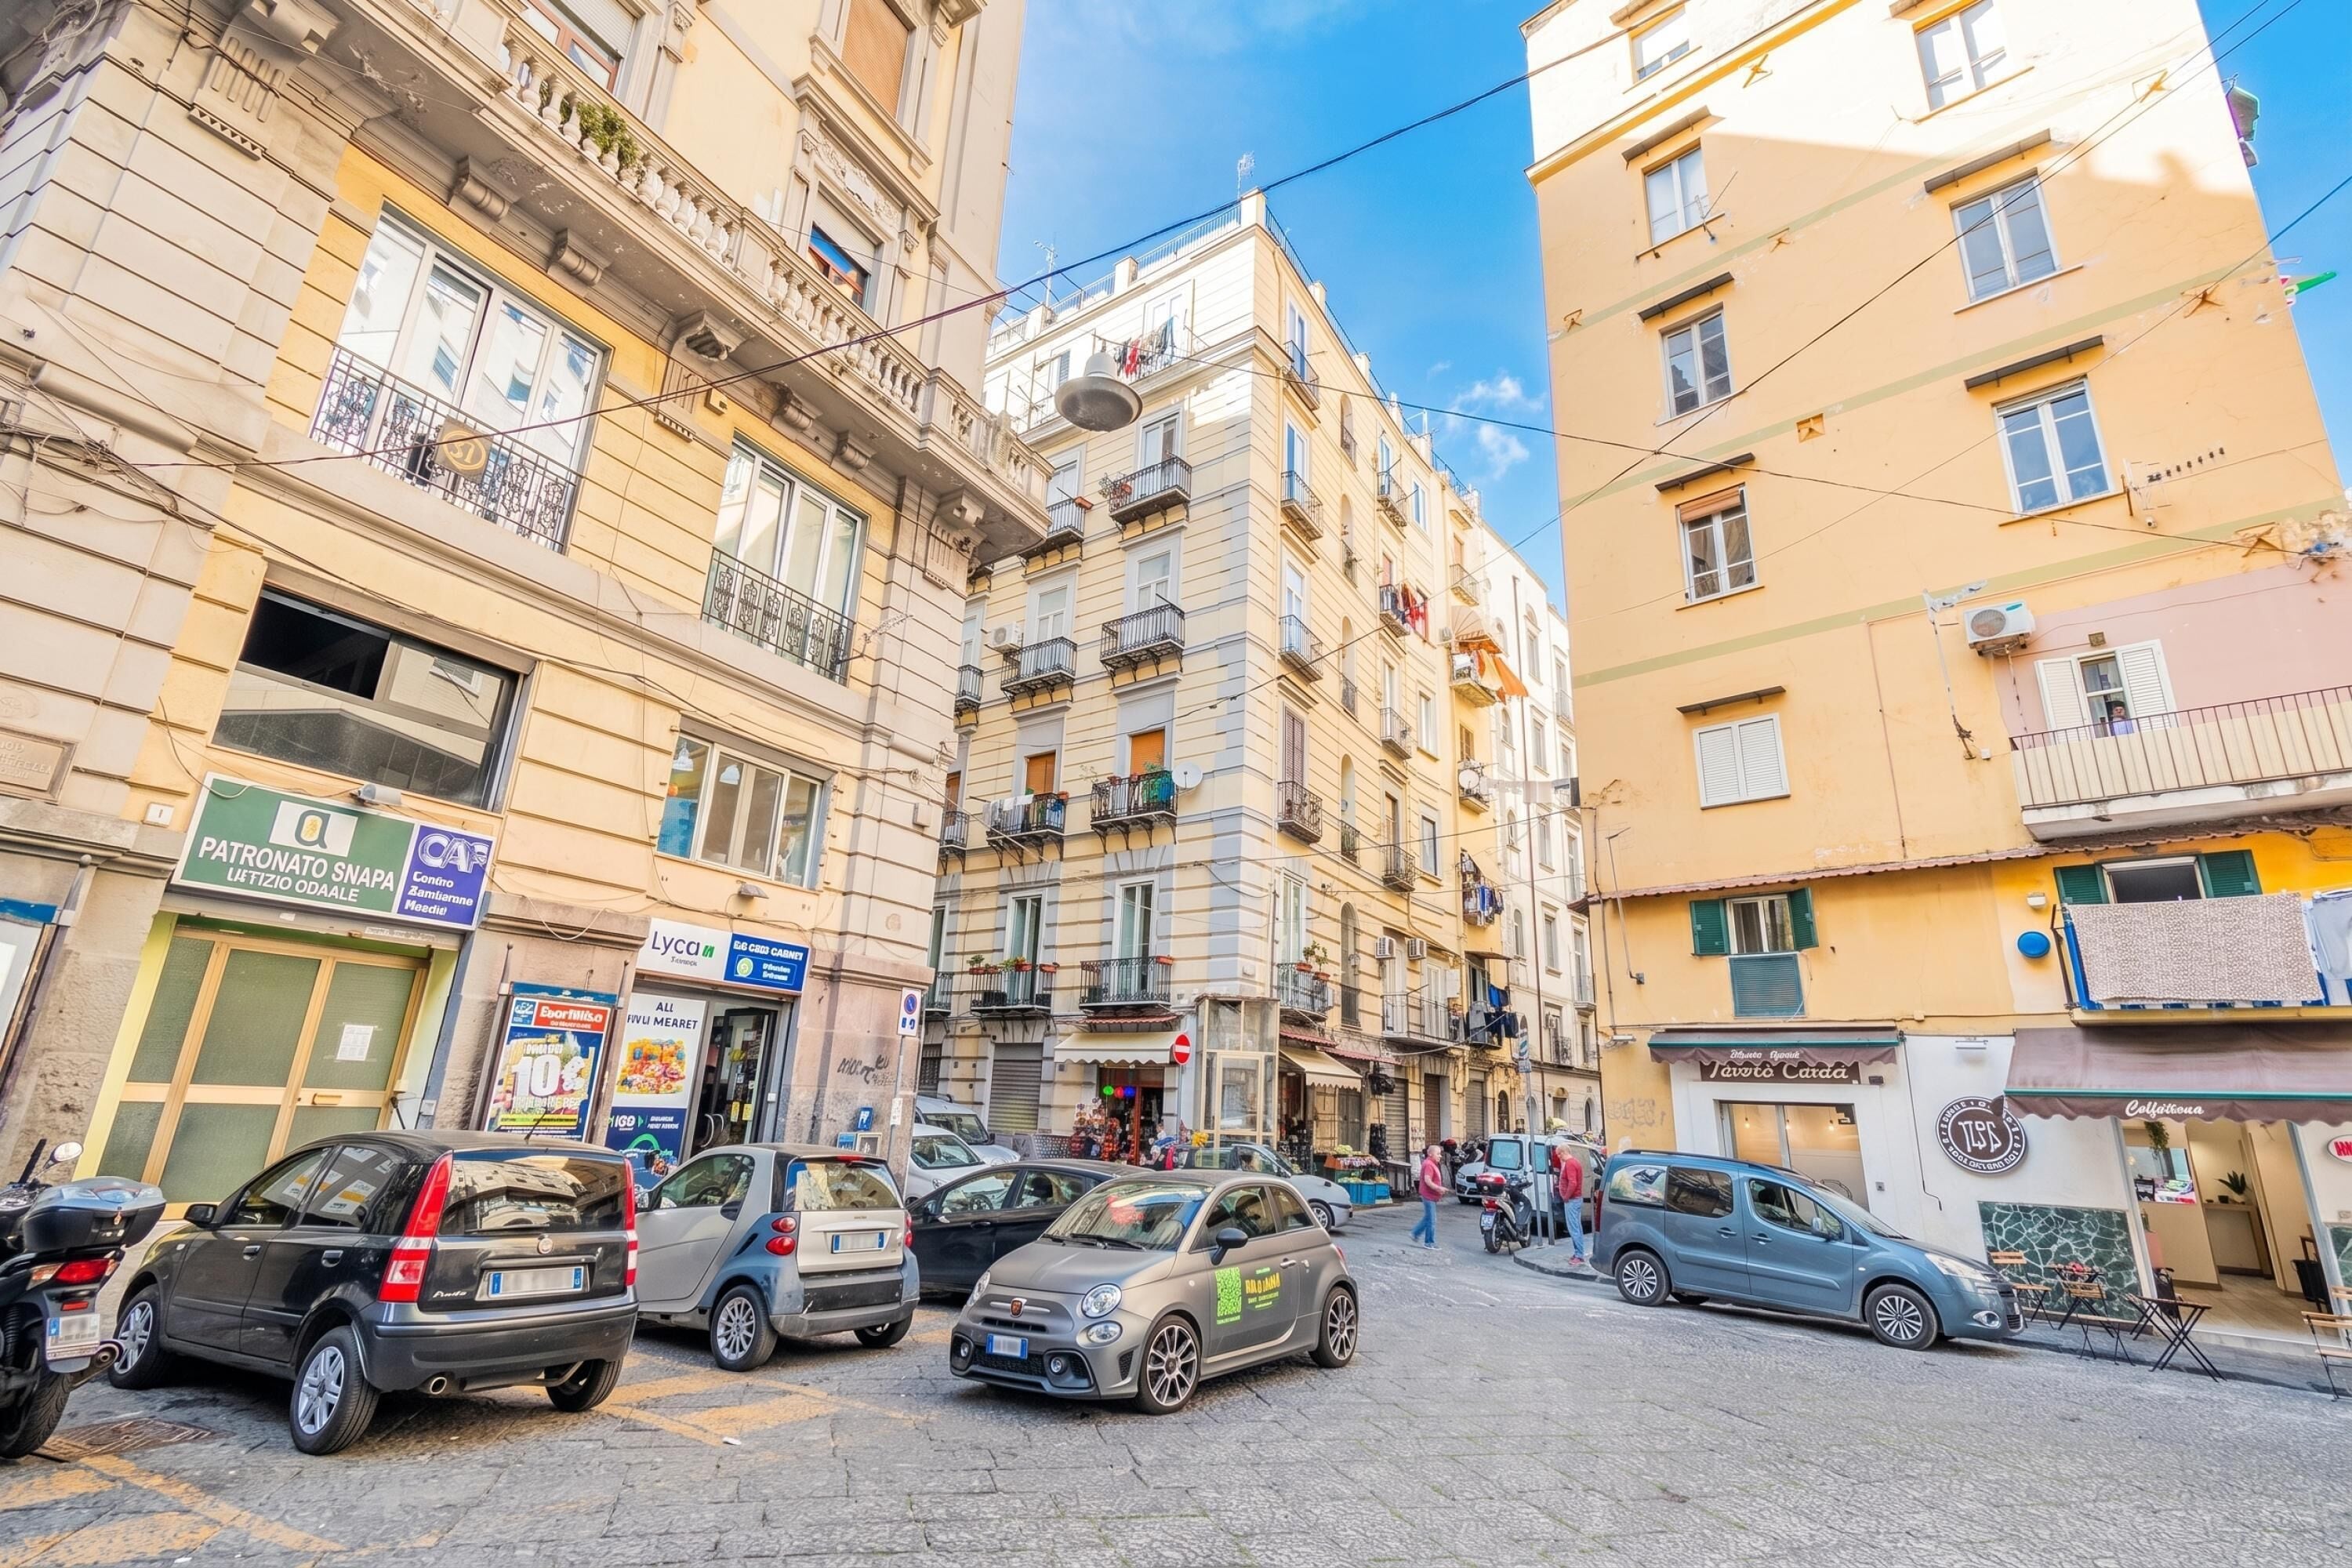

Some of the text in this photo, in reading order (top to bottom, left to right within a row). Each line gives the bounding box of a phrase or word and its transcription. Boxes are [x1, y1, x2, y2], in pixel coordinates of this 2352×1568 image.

[198, 836, 394, 892] PATRONATO SNAPA
[294, 879, 360, 902] ODAALE
[652, 931, 700, 956] Lyca
